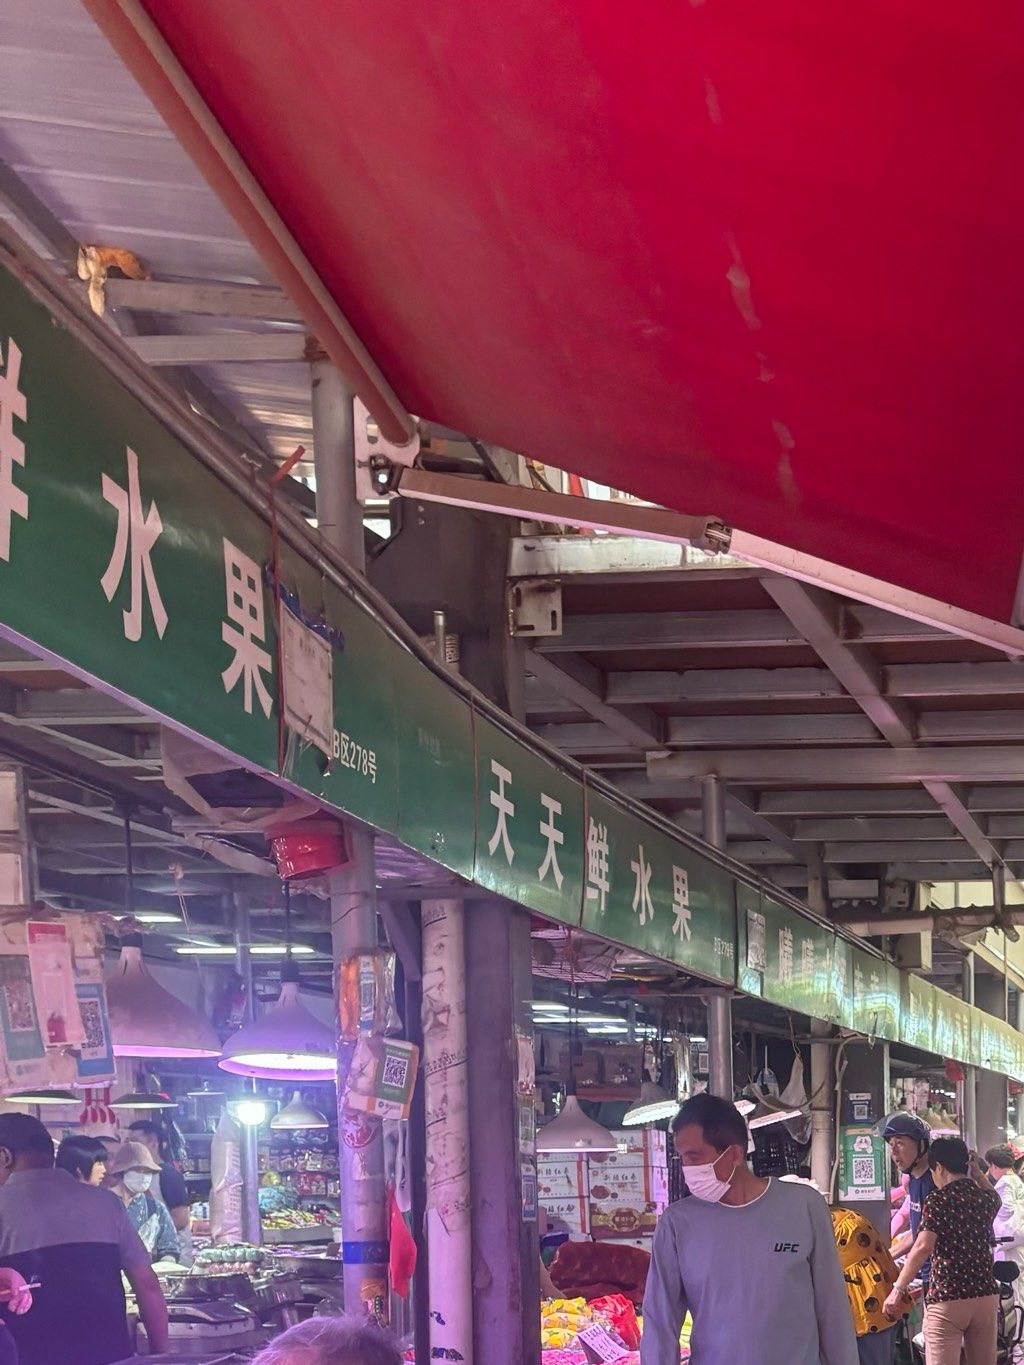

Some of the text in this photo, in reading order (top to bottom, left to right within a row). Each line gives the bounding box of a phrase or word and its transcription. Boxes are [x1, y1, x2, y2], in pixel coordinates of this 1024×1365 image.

[332, 729, 377, 784] B区278号
[488, 759, 692, 941] 天天鲜水果
[773, 1242, 800, 1253] UFC
